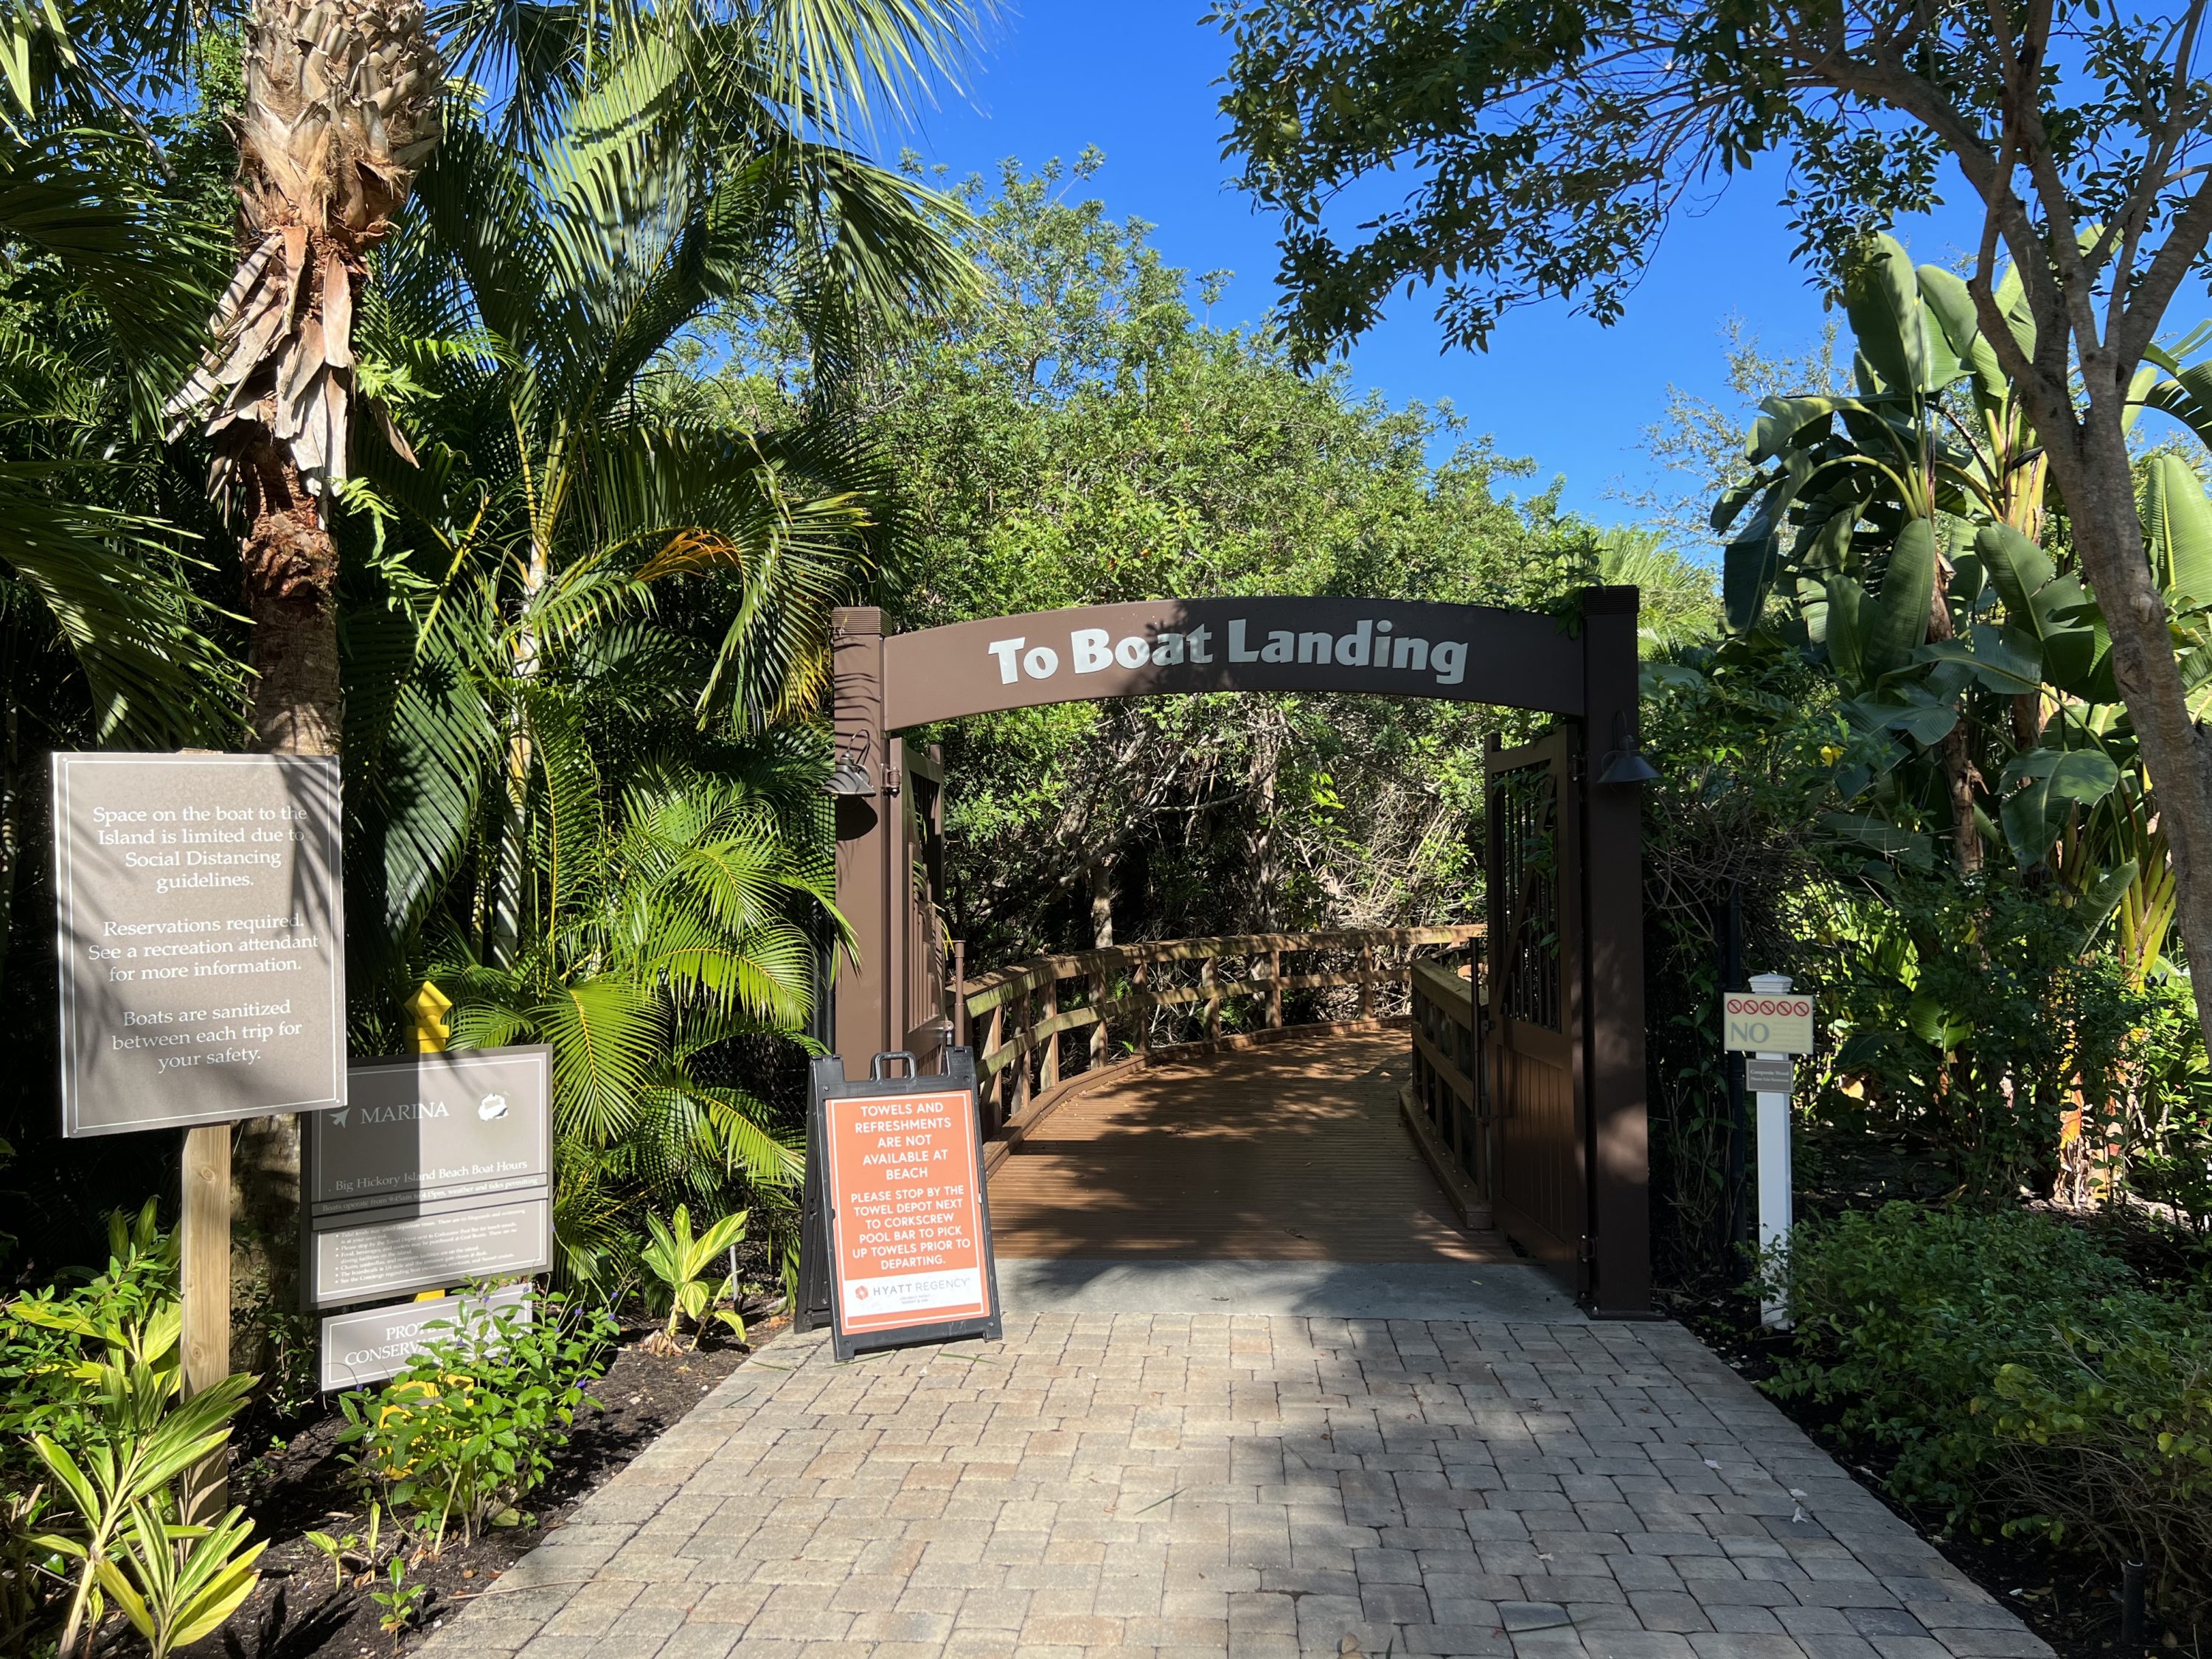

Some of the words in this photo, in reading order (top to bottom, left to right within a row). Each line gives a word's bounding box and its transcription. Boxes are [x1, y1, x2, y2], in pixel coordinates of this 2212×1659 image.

[988, 636, 1058, 685] To
[1071, 623, 1214, 674] Boat
[1228, 619, 1469, 685] Landing
[93, 807, 147, 827] Space
[152, 810, 177, 821] on
[181, 805, 211, 821] the
[216, 804, 254, 820] boat
[259, 806, 275, 819] to
[280, 804, 307, 819] the
[97, 828, 155, 844] Island
[161, 828, 176, 843] is
[182, 827, 245, 843] limited
[251, 827, 283, 841] due
[288, 828, 305, 841] to
[125, 851, 180, 867] Social
[187, 849, 282, 869] Distancing
[156, 872, 254, 894] guidelines.
[103, 917, 221, 936] Reservations
[226, 911, 304, 934] required.
[88, 945, 121, 959] See
[127, 947, 137, 958] a
[143, 938, 233, 956] recreation
[238, 934, 319, 952] attendant
[108, 966, 134, 981] for
[141, 966, 189, 979] more
[194, 956, 301, 975] information.
[123, 1010, 173, 1026] Boats
[178, 1009, 206, 1021] are
[212, 998, 291, 1019] sanitized
[111, 1033, 190, 1049] between
[196, 1025, 237, 1043] each
[242, 1023, 273, 1042] trip
[277, 1020, 302, 1036] for
[1731, 1022, 1770, 1043] NO
[158, 1054, 201, 1073] your
[206, 1047, 261, 1066] safety.
[360, 1102, 448, 1124] MARINA
[860, 1104, 913, 1117] TOWELS
[917, 1102, 944, 1114] AND
[855, 1117, 951, 1133] REFRESHMENTS
[877, 1136, 901, 1148] ARE
[905, 1134, 931, 1147] NOT
[862, 1150, 929, 1166] AVAILABLE
[933, 1149, 948, 1161] AT
[335, 1178, 354, 1192] Big
[357, 1174, 400, 1188] Hickory
[403, 1167, 436, 1183] Island
[439, 1164, 469, 1178] Beach
[472, 1163, 495, 1175] Boat
[496, 1160, 527, 1172] Hours
[886, 1166, 928, 1180] BEACH
[343, 1200, 369, 1210] operate
[448, 1186, 473, 1195] weather
[475, 1183, 487, 1192] and
[488, 1181, 504, 1190] tides
[505, 1178, 538, 1190] permitting
[851, 1190, 891, 1203] PLEASE
[895, 1187, 924, 1199] STOP
[927, 1186, 940, 1197] BY
[943, 1184, 964, 1196] THE
[853, 1203, 893, 1217] TOWEL
[897, 1200, 932, 1213] DEPOT
[936, 1198, 963, 1210] NEXT
[865, 1218, 880, 1229] TO
[884, 1212, 954, 1228] CORKSCREW
[859, 1231, 891, 1243] POOL
[894, 1229, 915, 1240] BAR
[918, 1227, 933, 1238] TO
[937, 1225, 961, 1237] PICK
[852, 1247, 867, 1258] UP
[870, 1242, 917, 1256] TOWELS
[920, 1239, 953, 1252] PRIOR
[955, 1238, 970, 1249] TO
[880, 1255, 945, 1270] DEPARTING.
[873, 1283, 912, 1296] HYATT
[386, 1312, 476, 1340] PROTTE
[345, 1331, 465, 1366] CONSERV
